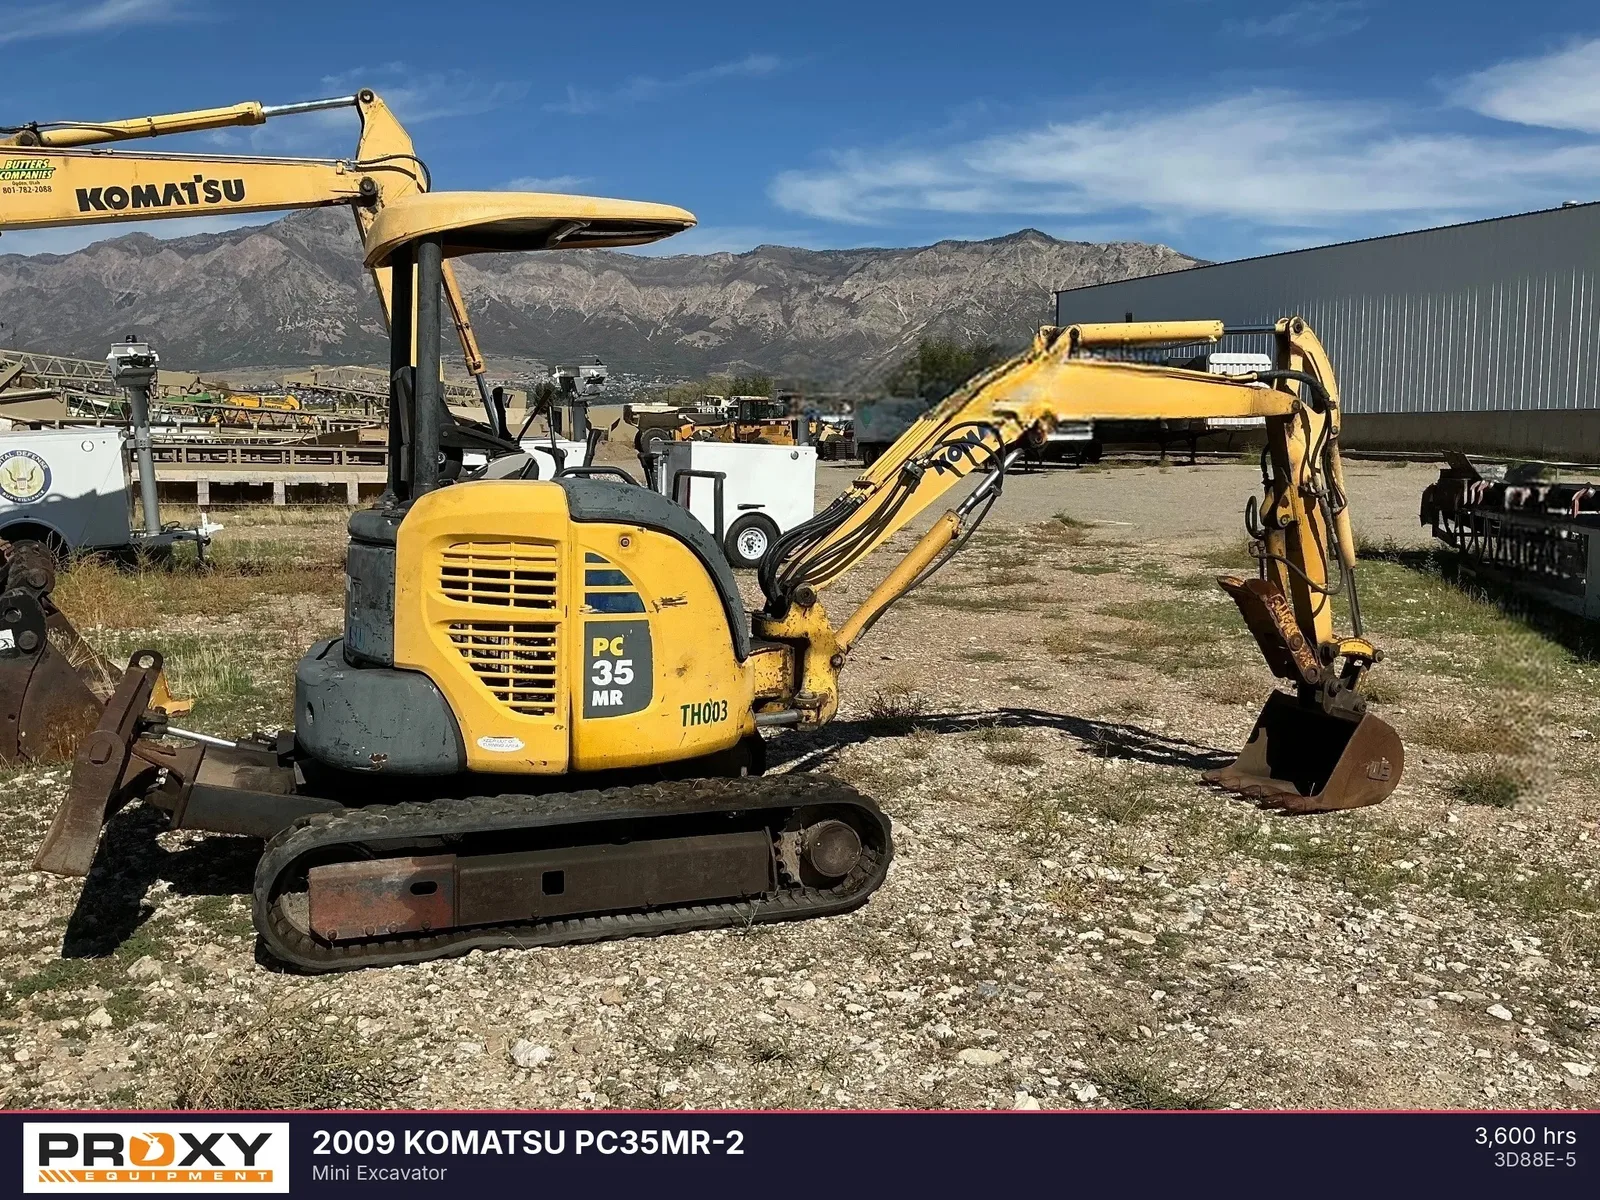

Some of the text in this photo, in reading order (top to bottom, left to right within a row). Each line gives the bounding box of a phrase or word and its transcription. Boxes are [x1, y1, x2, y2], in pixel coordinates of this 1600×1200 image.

[4, 159, 50, 169] BUTTERS
[0, 170, 53, 180] COMPANIES
[2, 185, 53, 194] 801-782-2088
[75, 174, 246, 212] KOMATSU
[16, 450, 49, 471] DEFENSE
[1, 489, 46, 502] SURVEILLANCE
[592, 636, 624, 657] PC
[591, 659, 635, 686] 35
[592, 689, 624, 706] MR
[680, 700, 728, 727] TH003
